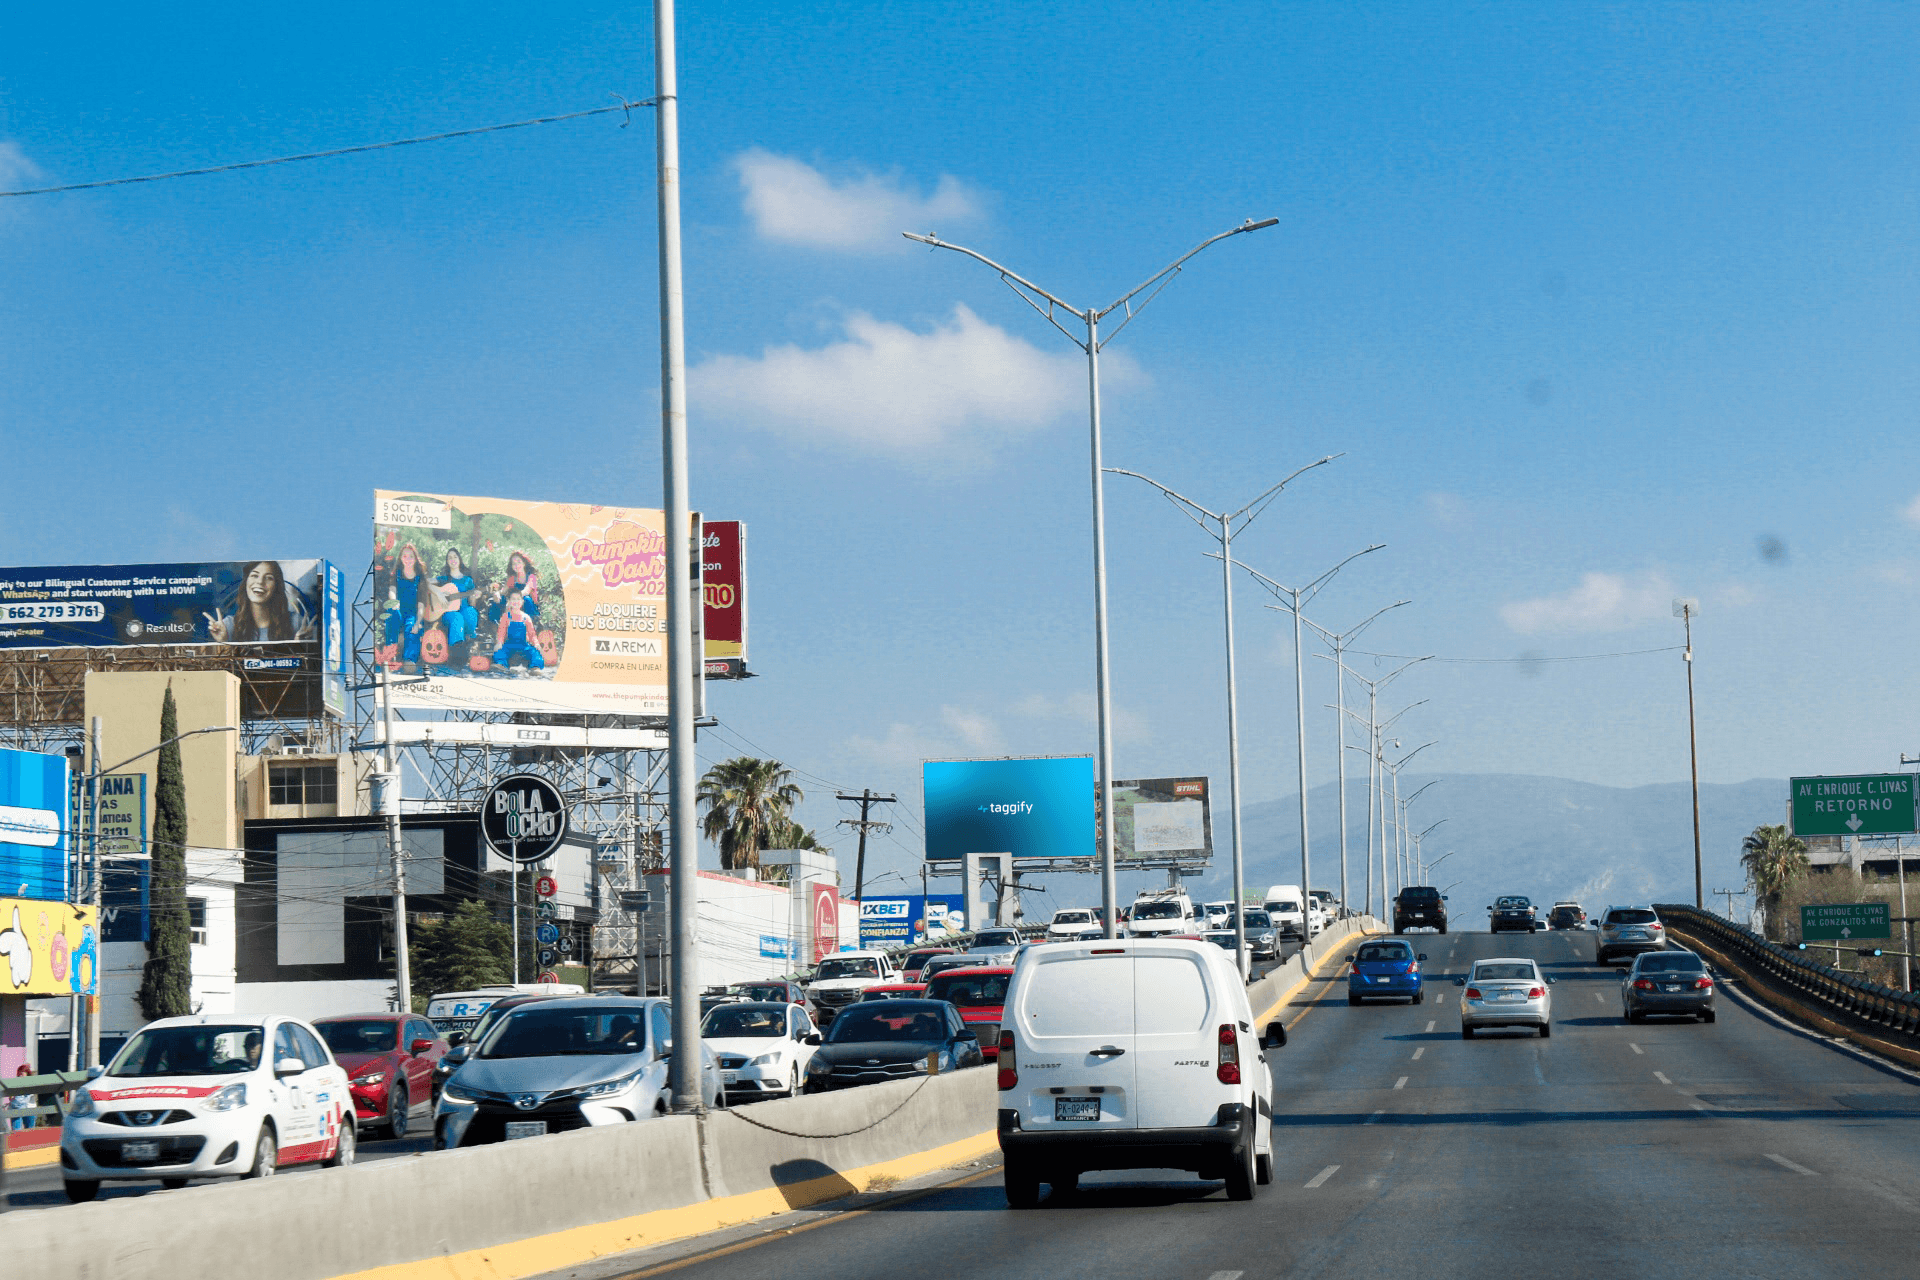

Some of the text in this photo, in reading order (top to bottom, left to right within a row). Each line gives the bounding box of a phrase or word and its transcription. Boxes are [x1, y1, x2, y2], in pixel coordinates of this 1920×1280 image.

[383, 502, 426, 515] 5 OCT AL
[383, 512, 440, 525] 5 NOV 2023
[16, 580, 26, 588] to
[27, 580, 43, 588] our
[45, 578, 86, 589] Bilingual
[87, 578, 131, 587] Customer
[133, 576, 166, 585] Service
[168, 575, 213, 586] campaign
[638, 580, 665, 595] 202
[2, 589, 51, 599] WhatsApp
[52, 589, 70, 597] and
[71, 588, 94, 597] start
[95, 588, 132, 598] working
[134, 587, 155, 595] with
[169, 586, 196, 595] NOW!
[9, 605, 99, 618] 662 279 3761
[593, 602, 657, 618] ADQUIERE
[146, 623, 196, 633] ResultsCX
[570, 614, 668, 633] TUS BOLETOS E
[612, 641, 657, 653] AREMA
[626, 662, 637, 670] EN
[430, 684, 444, 692] 212
[1177, 785, 1201, 793] STIHL
[1799, 780, 1908, 796] AV. ENRIQUE C. LIVAS
[494, 788, 543, 814] BOLA
[1815, 798, 1892, 812] RETORNO
[990, 801, 1034, 815] taggify
[507, 812, 556, 838] OCHO
[862, 904, 907, 915] 1XBET
[1806, 908, 1817, 917] AV.
[1819, 907, 1852, 916] ENRIQUE
[1864, 906, 1884, 915] LIVAS
[1806, 916, 1886, 926] AV. GONZALITOS NTE.
[110, 1087, 188, 1097] TOSHIBA
